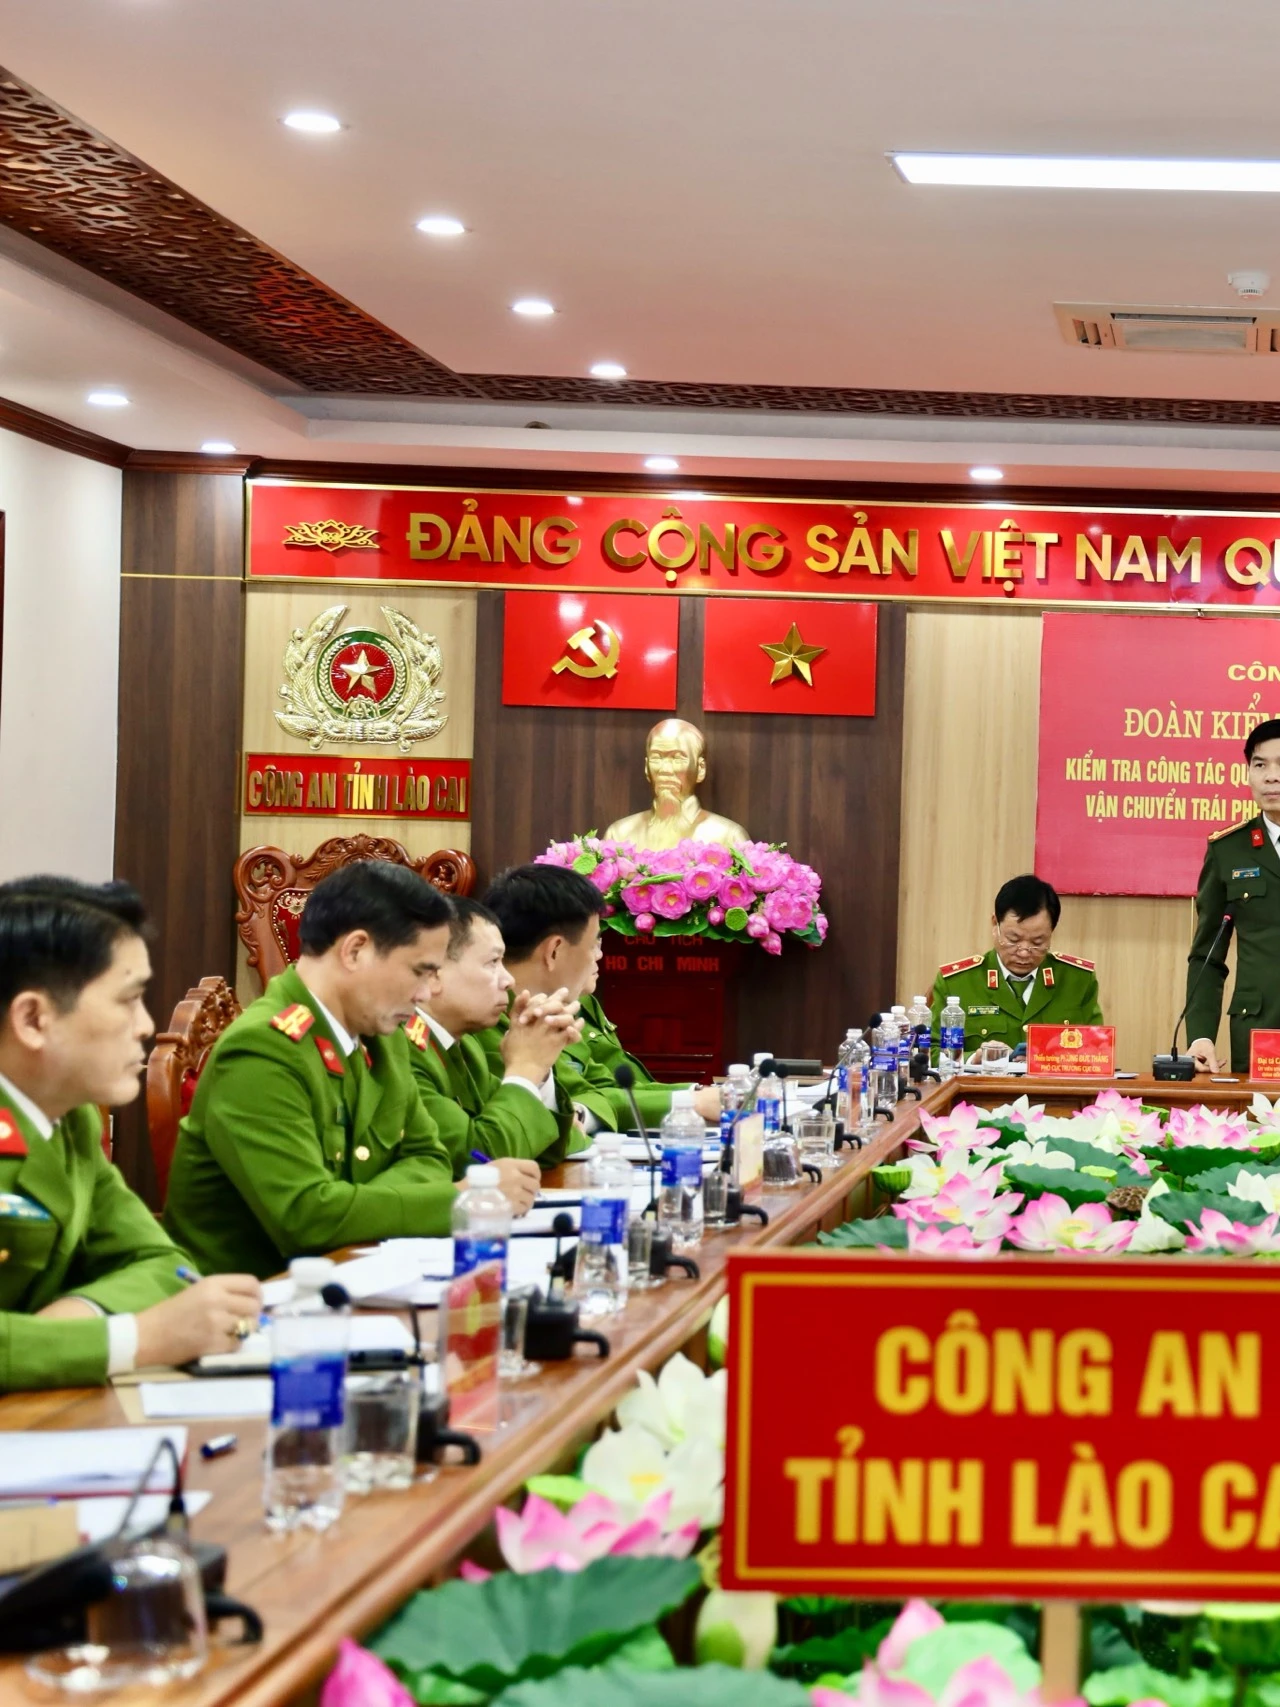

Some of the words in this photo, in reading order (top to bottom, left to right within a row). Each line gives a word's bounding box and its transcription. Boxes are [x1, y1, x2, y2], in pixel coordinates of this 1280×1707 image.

[406, 499, 581, 564] ĐẢNG
[602, 506, 784, 582] CỘNG
[804, 512, 918, 576] SẢN
[941, 518, 1059, 592] VIỆT
[1075, 535, 1203, 583] NAM
[1123, 699, 1205, 739] ĐOÀN
[249, 765, 303, 807] CÔNG
[307, 773, 336, 808] AN
[343, 761, 388, 810] TỈNH
[392, 767, 430, 811] LÀO
[433, 776, 466, 812] CAI
[1065, 748, 1107, 782] KIỂM
[1111, 759, 1142, 782] TRA
[1146, 755, 1191, 784] CÔNG
[1194, 757, 1226, 786] TÁC
[1085, 790, 1119, 822] VẬN
[1122, 787, 1187, 821] CHUYỂN
[1190, 793, 1227, 822] TRÁI
[874, 1309, 1113, 1416] CÔNG
[1136, 1331, 1262, 1418] AN
[784, 1425, 984, 1546] TỈNH
[1009, 1442, 1174, 1550] LÀO
